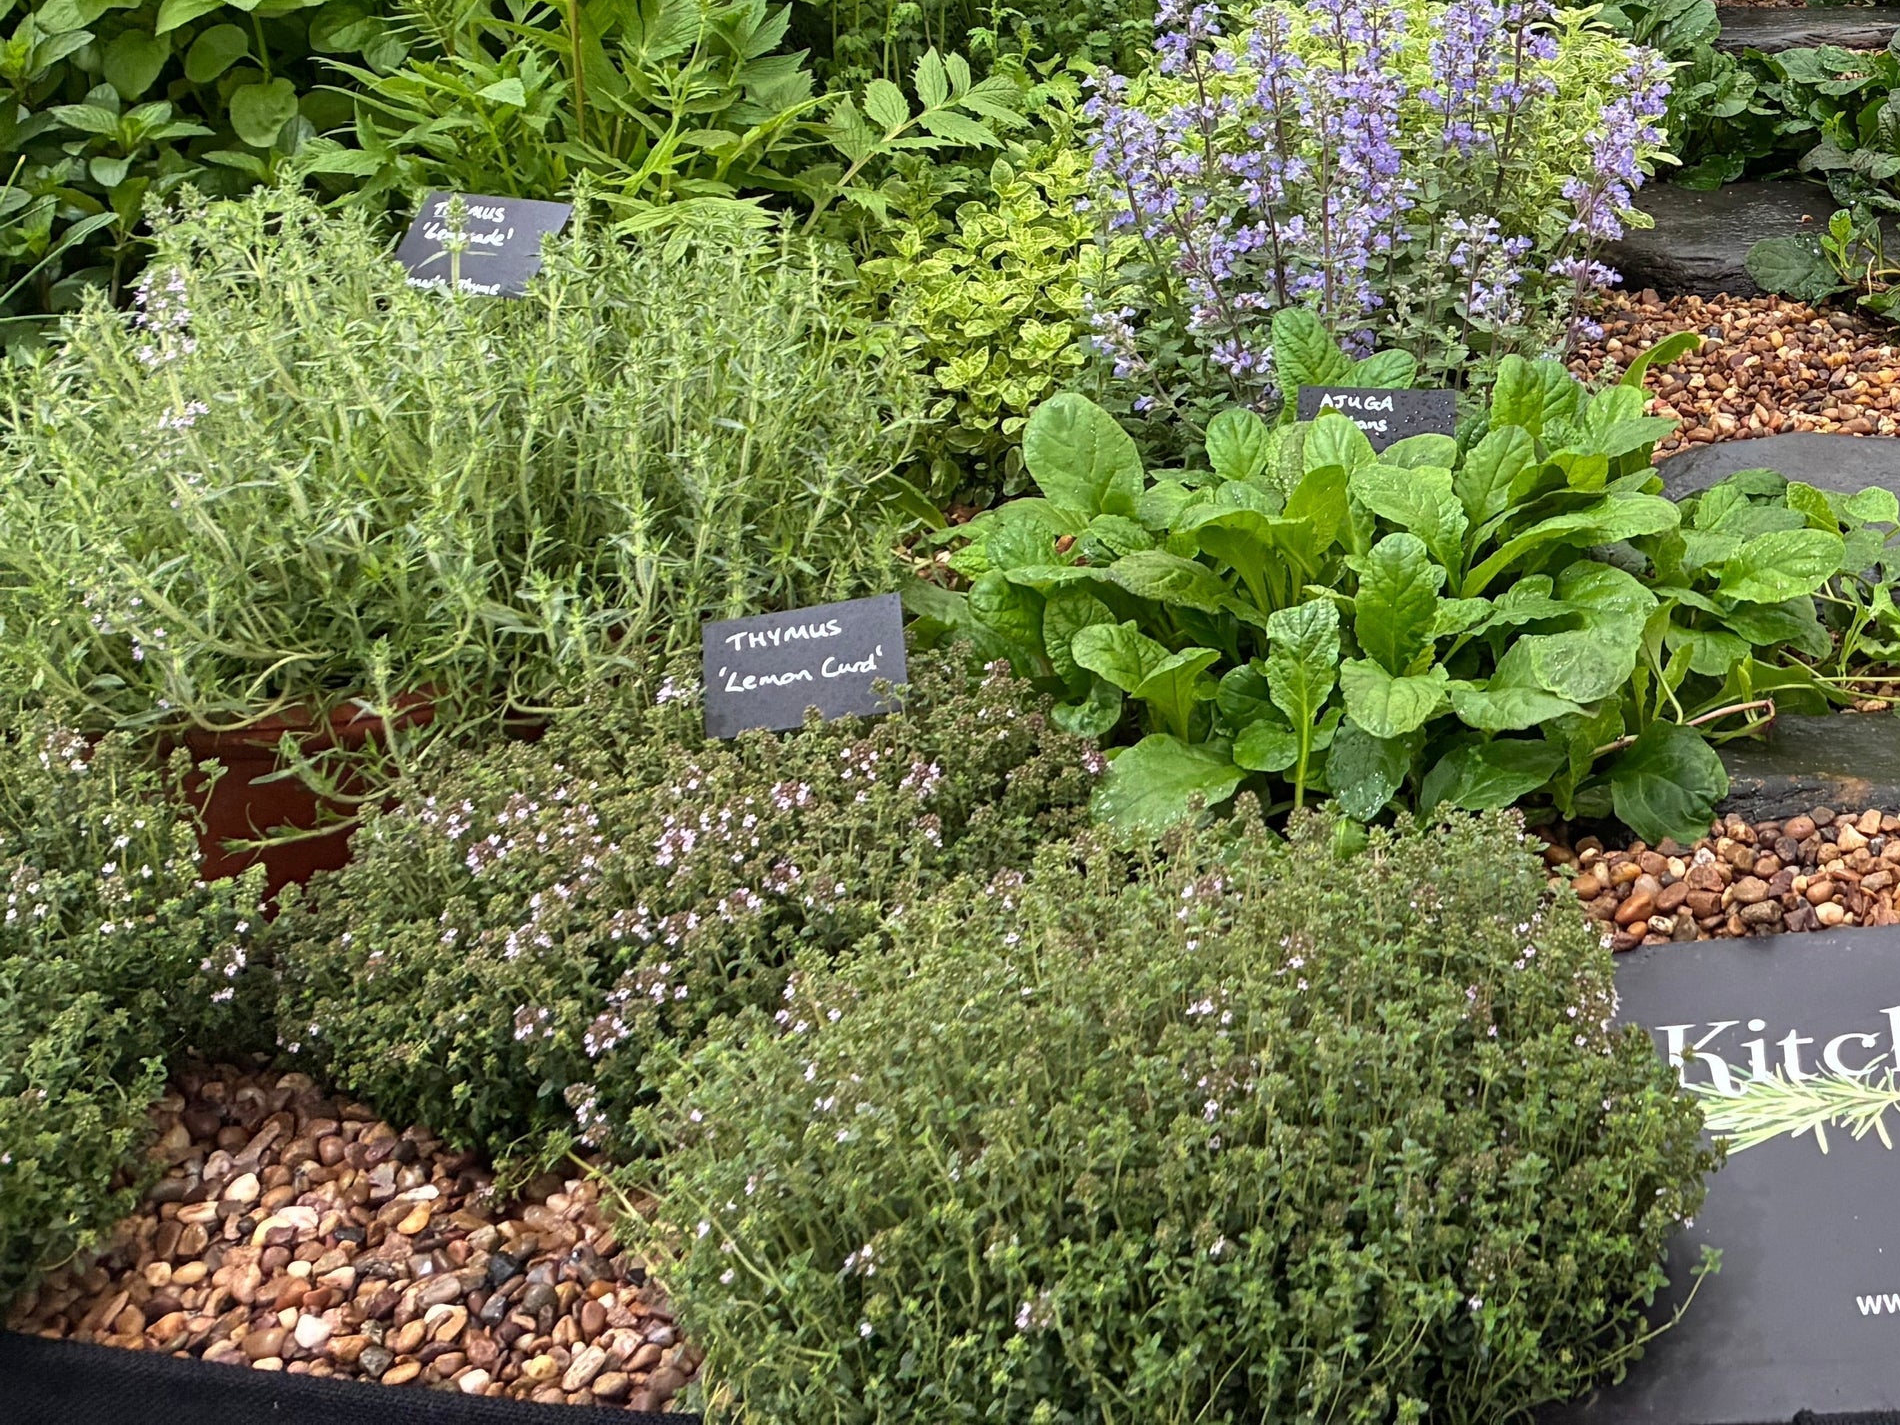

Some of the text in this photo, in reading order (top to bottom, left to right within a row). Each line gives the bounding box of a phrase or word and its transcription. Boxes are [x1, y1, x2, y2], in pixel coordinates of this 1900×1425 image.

[1320, 393, 1393, 412] AJUGA
[725, 619, 842, 652] THYMUS
[718, 666, 813, 692] 'Lemon
